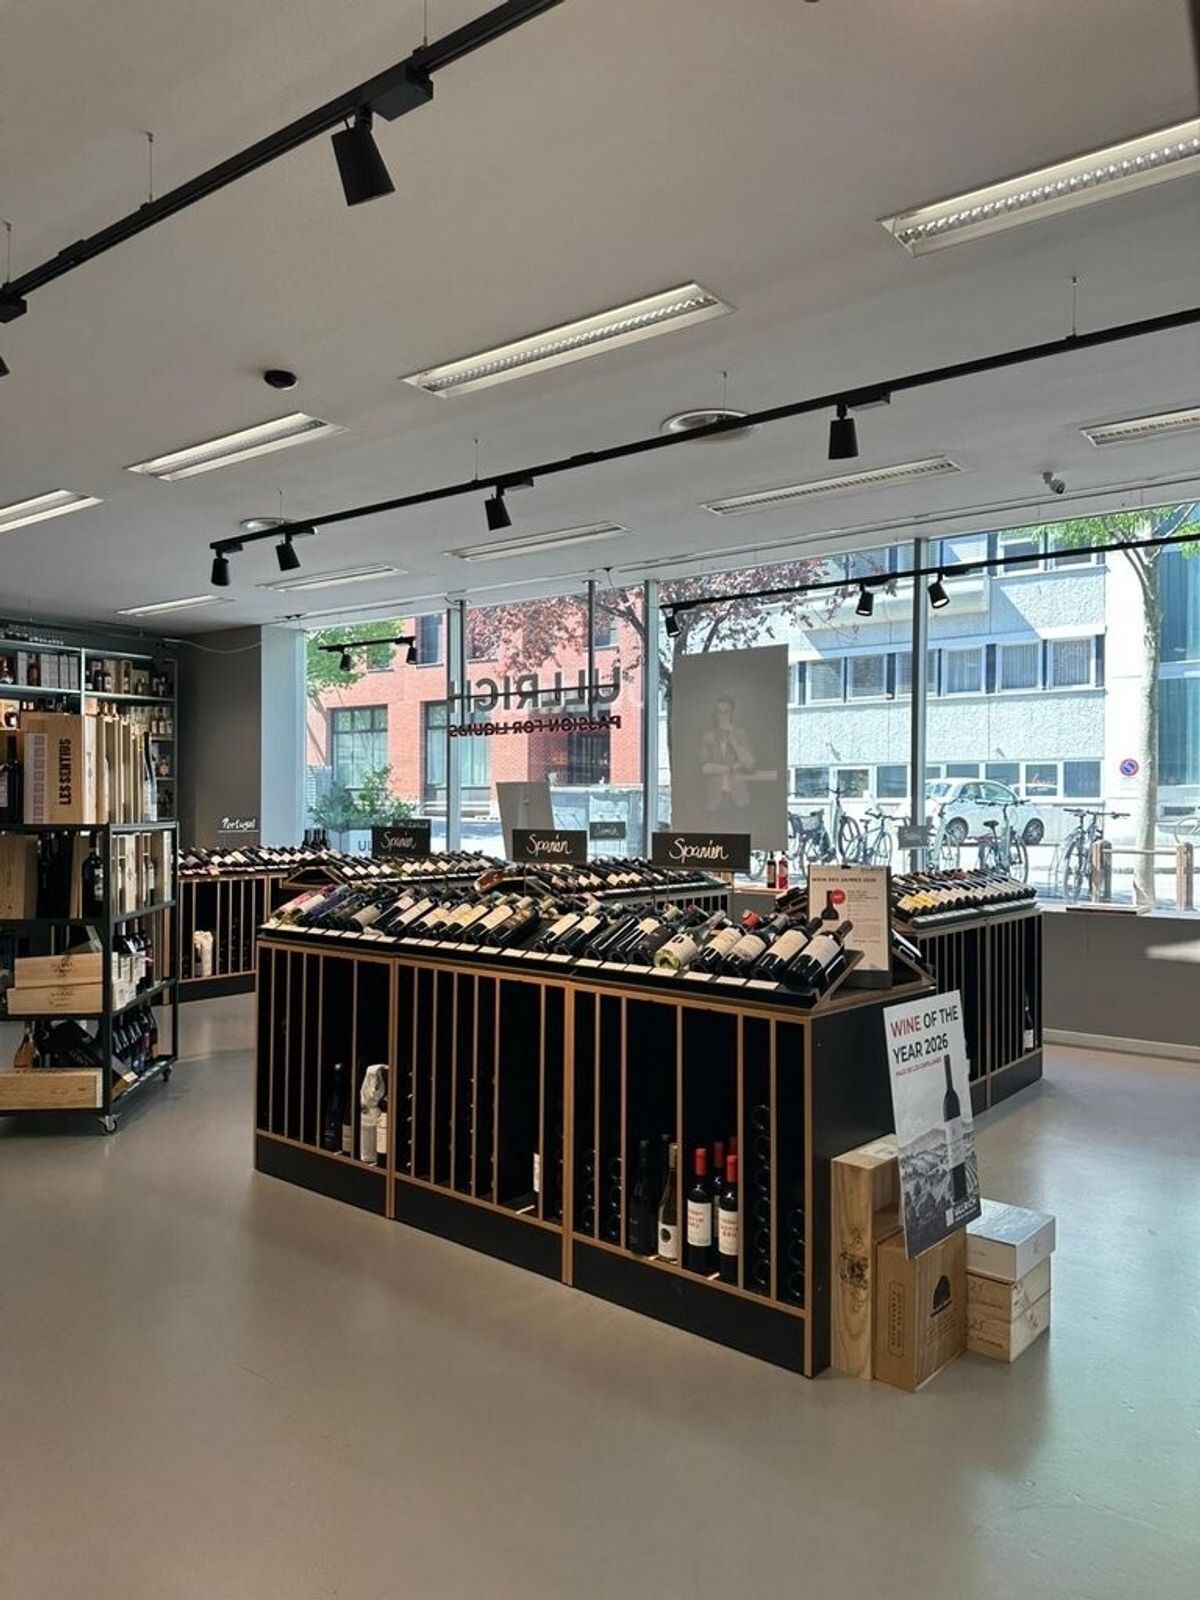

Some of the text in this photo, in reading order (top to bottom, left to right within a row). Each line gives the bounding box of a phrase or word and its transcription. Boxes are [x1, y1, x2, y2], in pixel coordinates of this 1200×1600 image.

[221, 816, 256, 831] Portugal
[668, 837, 730, 863] Spanien
[890, 1005, 959, 1038] WINE OF THE
[892, 1033, 949, 1065] YEAR 2026
